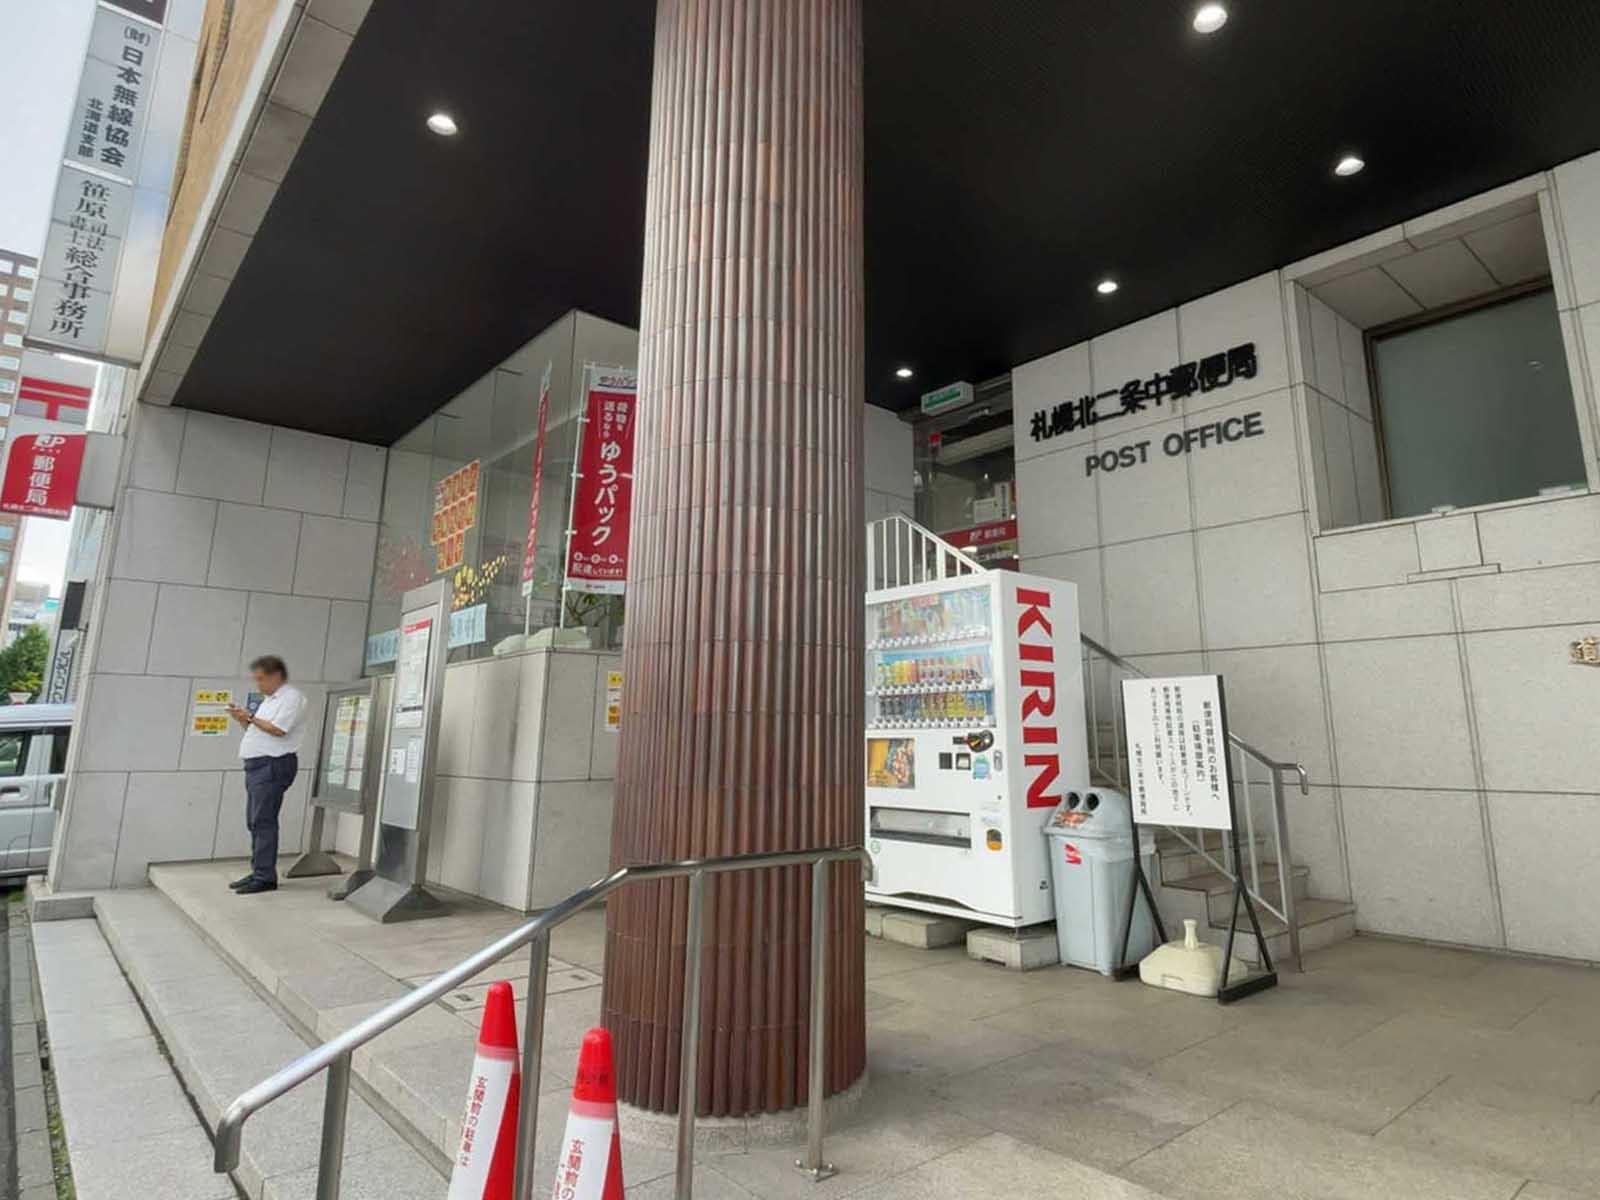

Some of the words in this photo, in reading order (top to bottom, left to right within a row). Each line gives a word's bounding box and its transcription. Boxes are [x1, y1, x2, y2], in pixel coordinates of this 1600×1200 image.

[77, 97, 104, 158] 北海道支部
[1030, 341, 1258, 442] 札幌北二条中郵便局
[25, 454, 56, 506] 郵便局
[1086, 441, 1150, 477] POST
[1162, 411, 1264, 457] OFFICE
[592, 440, 622, 547] ゆうパック
[1016, 587, 1062, 809] KIRIN
